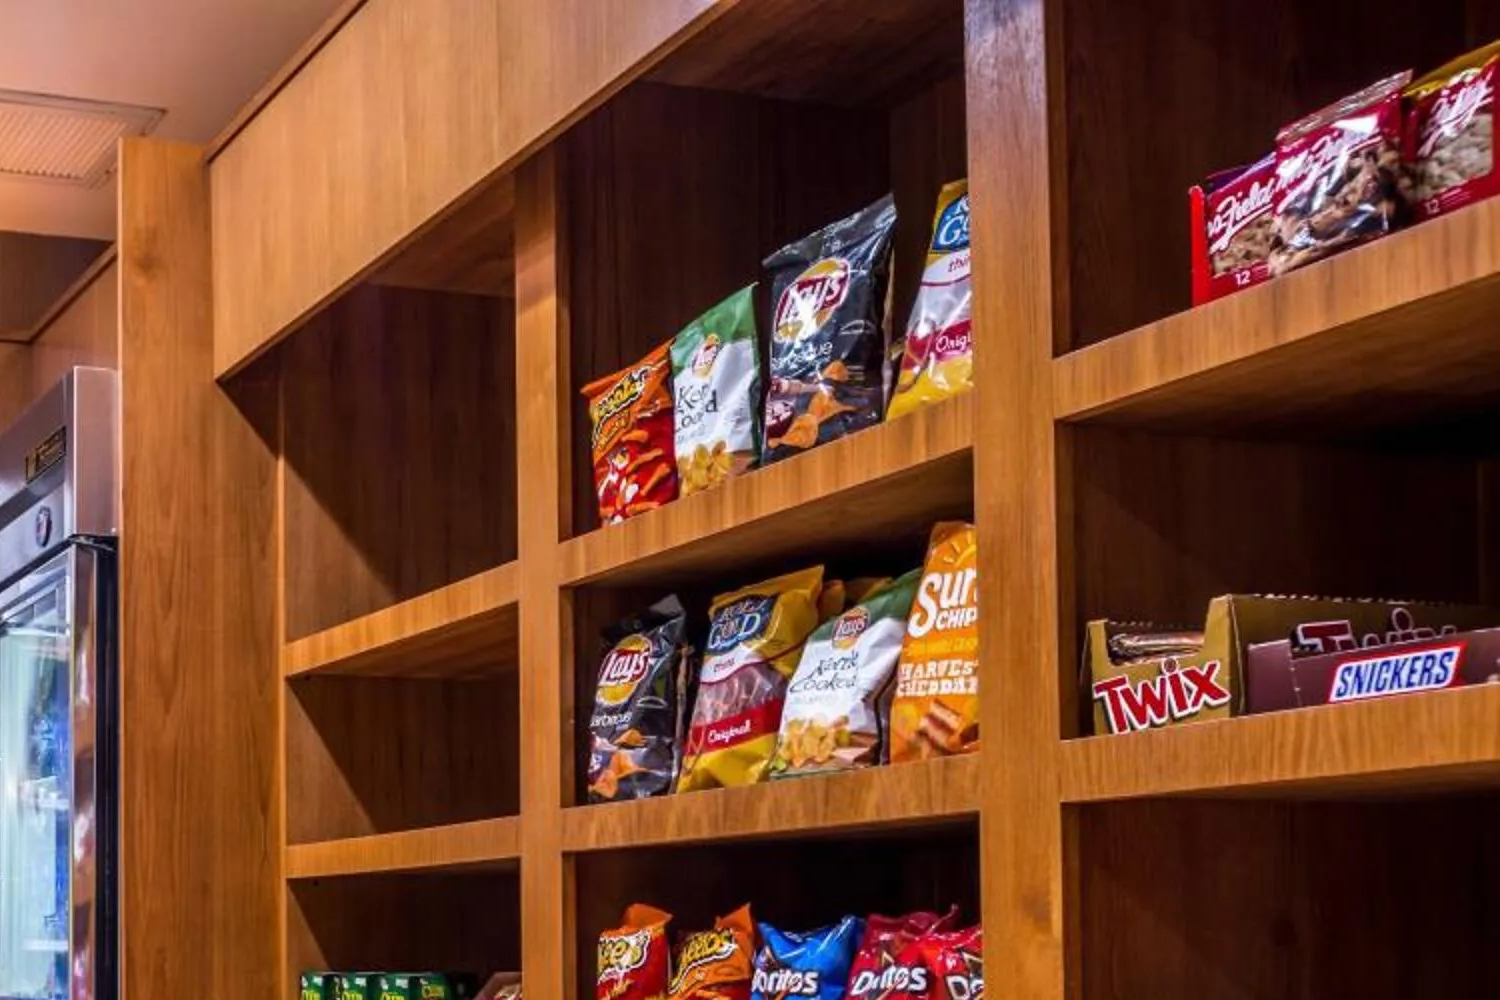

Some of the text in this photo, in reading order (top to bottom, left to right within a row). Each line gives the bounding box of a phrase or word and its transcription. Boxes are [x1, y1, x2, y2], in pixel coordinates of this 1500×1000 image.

[1235, 270, 1251, 286] 12
[936, 608, 977, 631] CHIP
[1334, 649, 1457, 700] SNICKERS
[851, 966, 928, 996] Doritos
